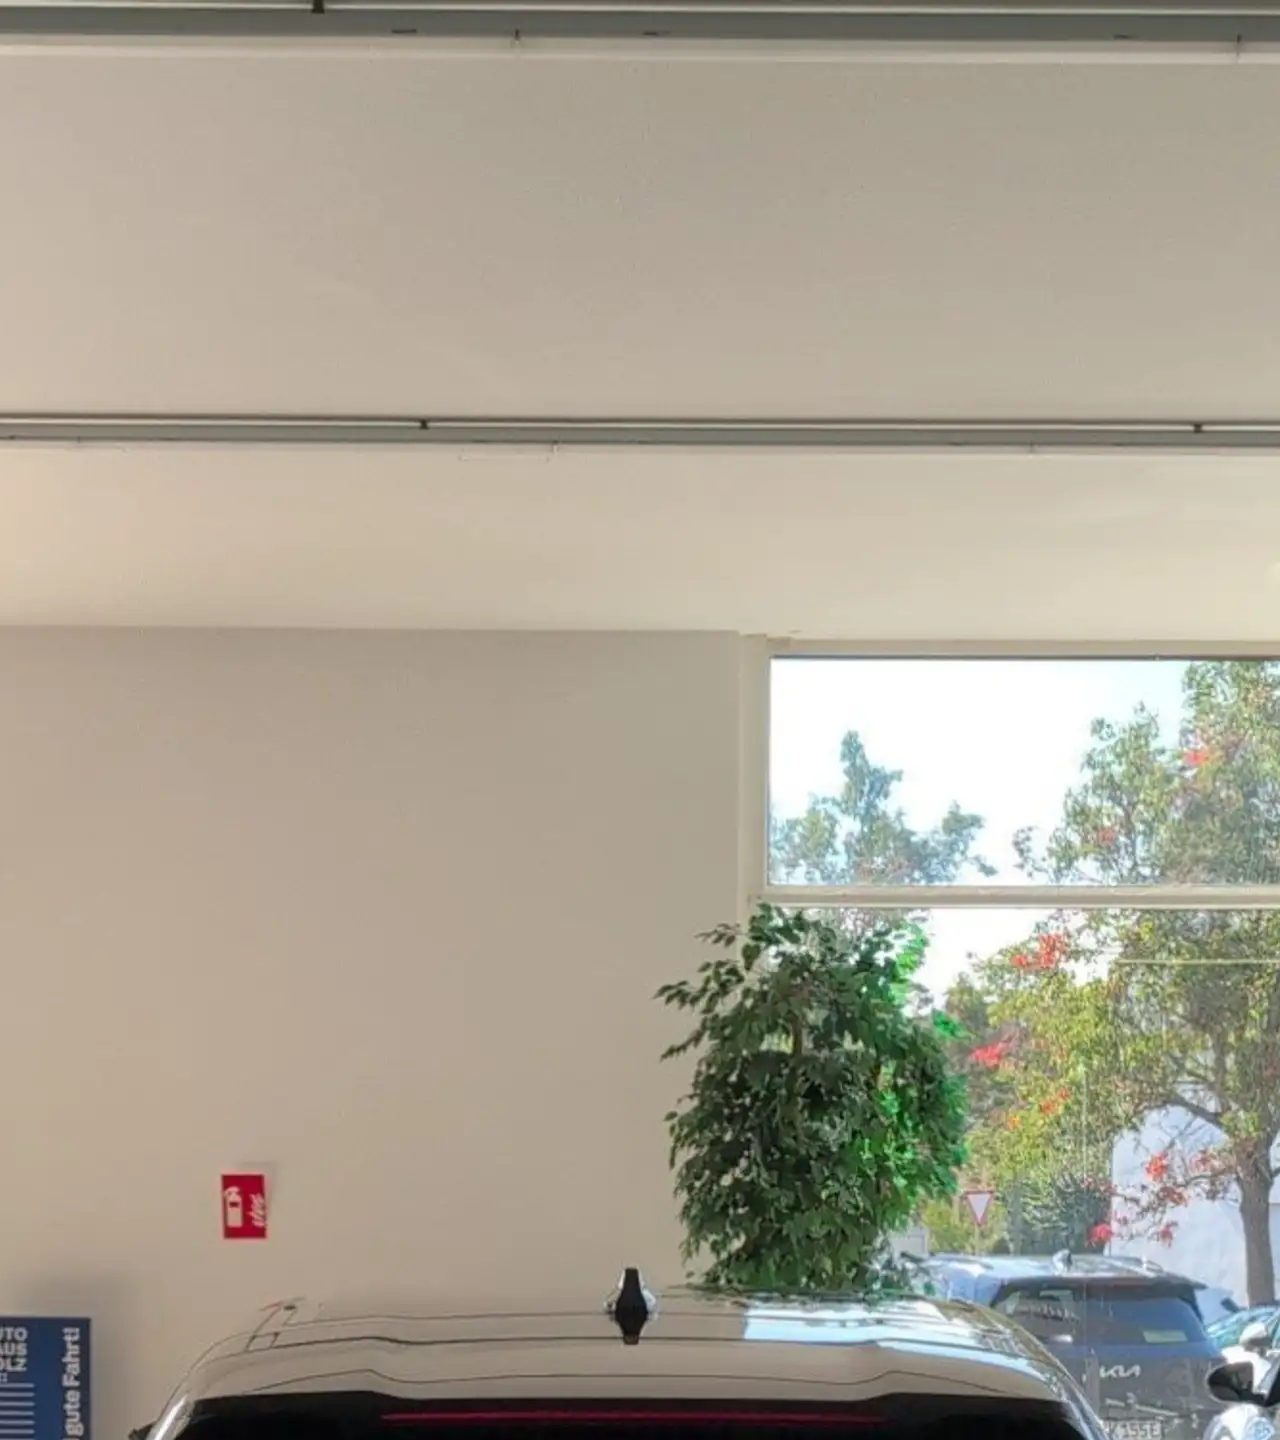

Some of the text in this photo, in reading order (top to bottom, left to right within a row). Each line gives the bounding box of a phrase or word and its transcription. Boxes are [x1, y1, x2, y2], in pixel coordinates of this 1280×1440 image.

[62, 1327, 81, 1386] Fahrt!
[1099, 1364, 1141, 1378] KIA
[63, 1390, 84, 1437] gute
